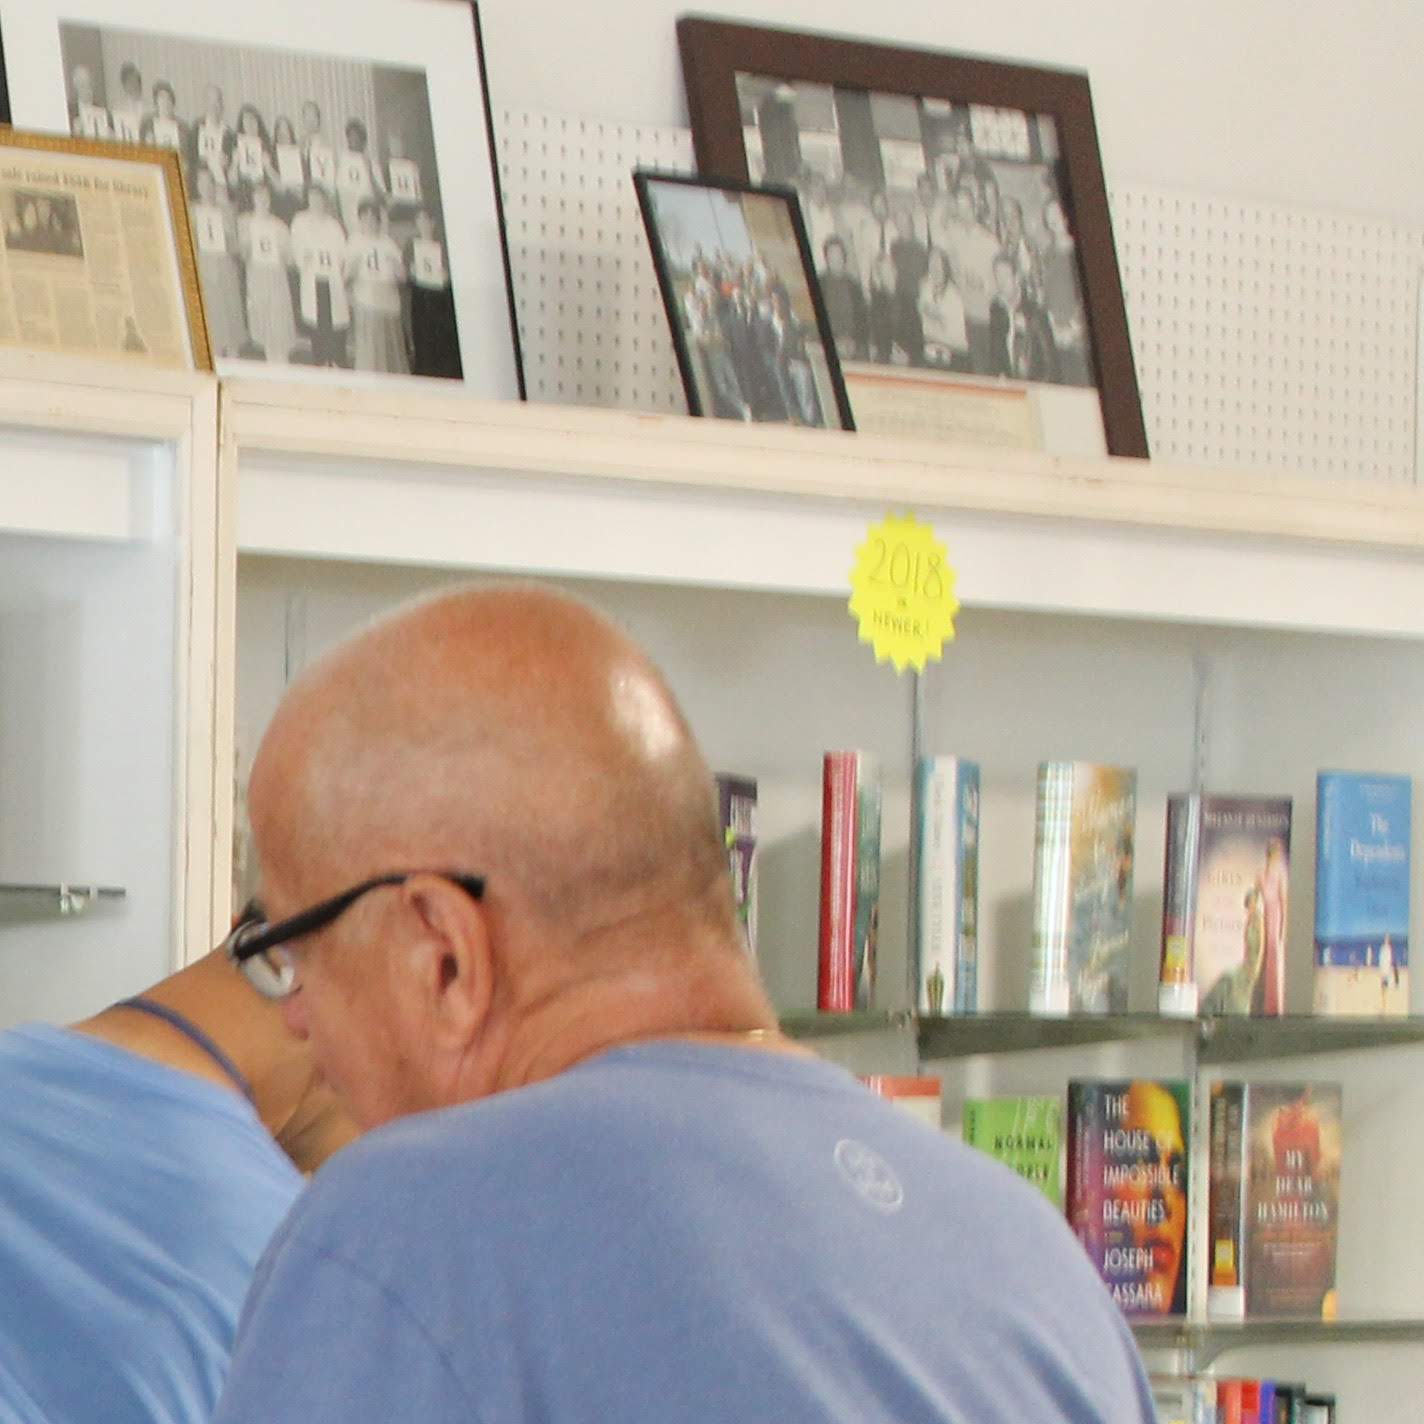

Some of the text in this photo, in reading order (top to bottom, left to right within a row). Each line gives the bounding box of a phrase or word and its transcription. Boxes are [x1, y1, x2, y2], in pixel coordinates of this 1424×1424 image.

[868, 537, 943, 599] 2018
[1104, 1094, 1129, 1120] THE
[994, 1135, 1053, 1151] NORMAL
[1103, 1129, 1150, 1152] HOUSE
[1285, 1149, 1304, 1169] MY
[1103, 1163, 1179, 1188] IMPOSSIBLE
[1275, 1175, 1312, 1196] DEAR
[1103, 1199, 1166, 1225] BEAUTIES
[1257, 1201, 1329, 1224] HAMILTON
[1103, 1247, 1153, 1272] JOSEPH
